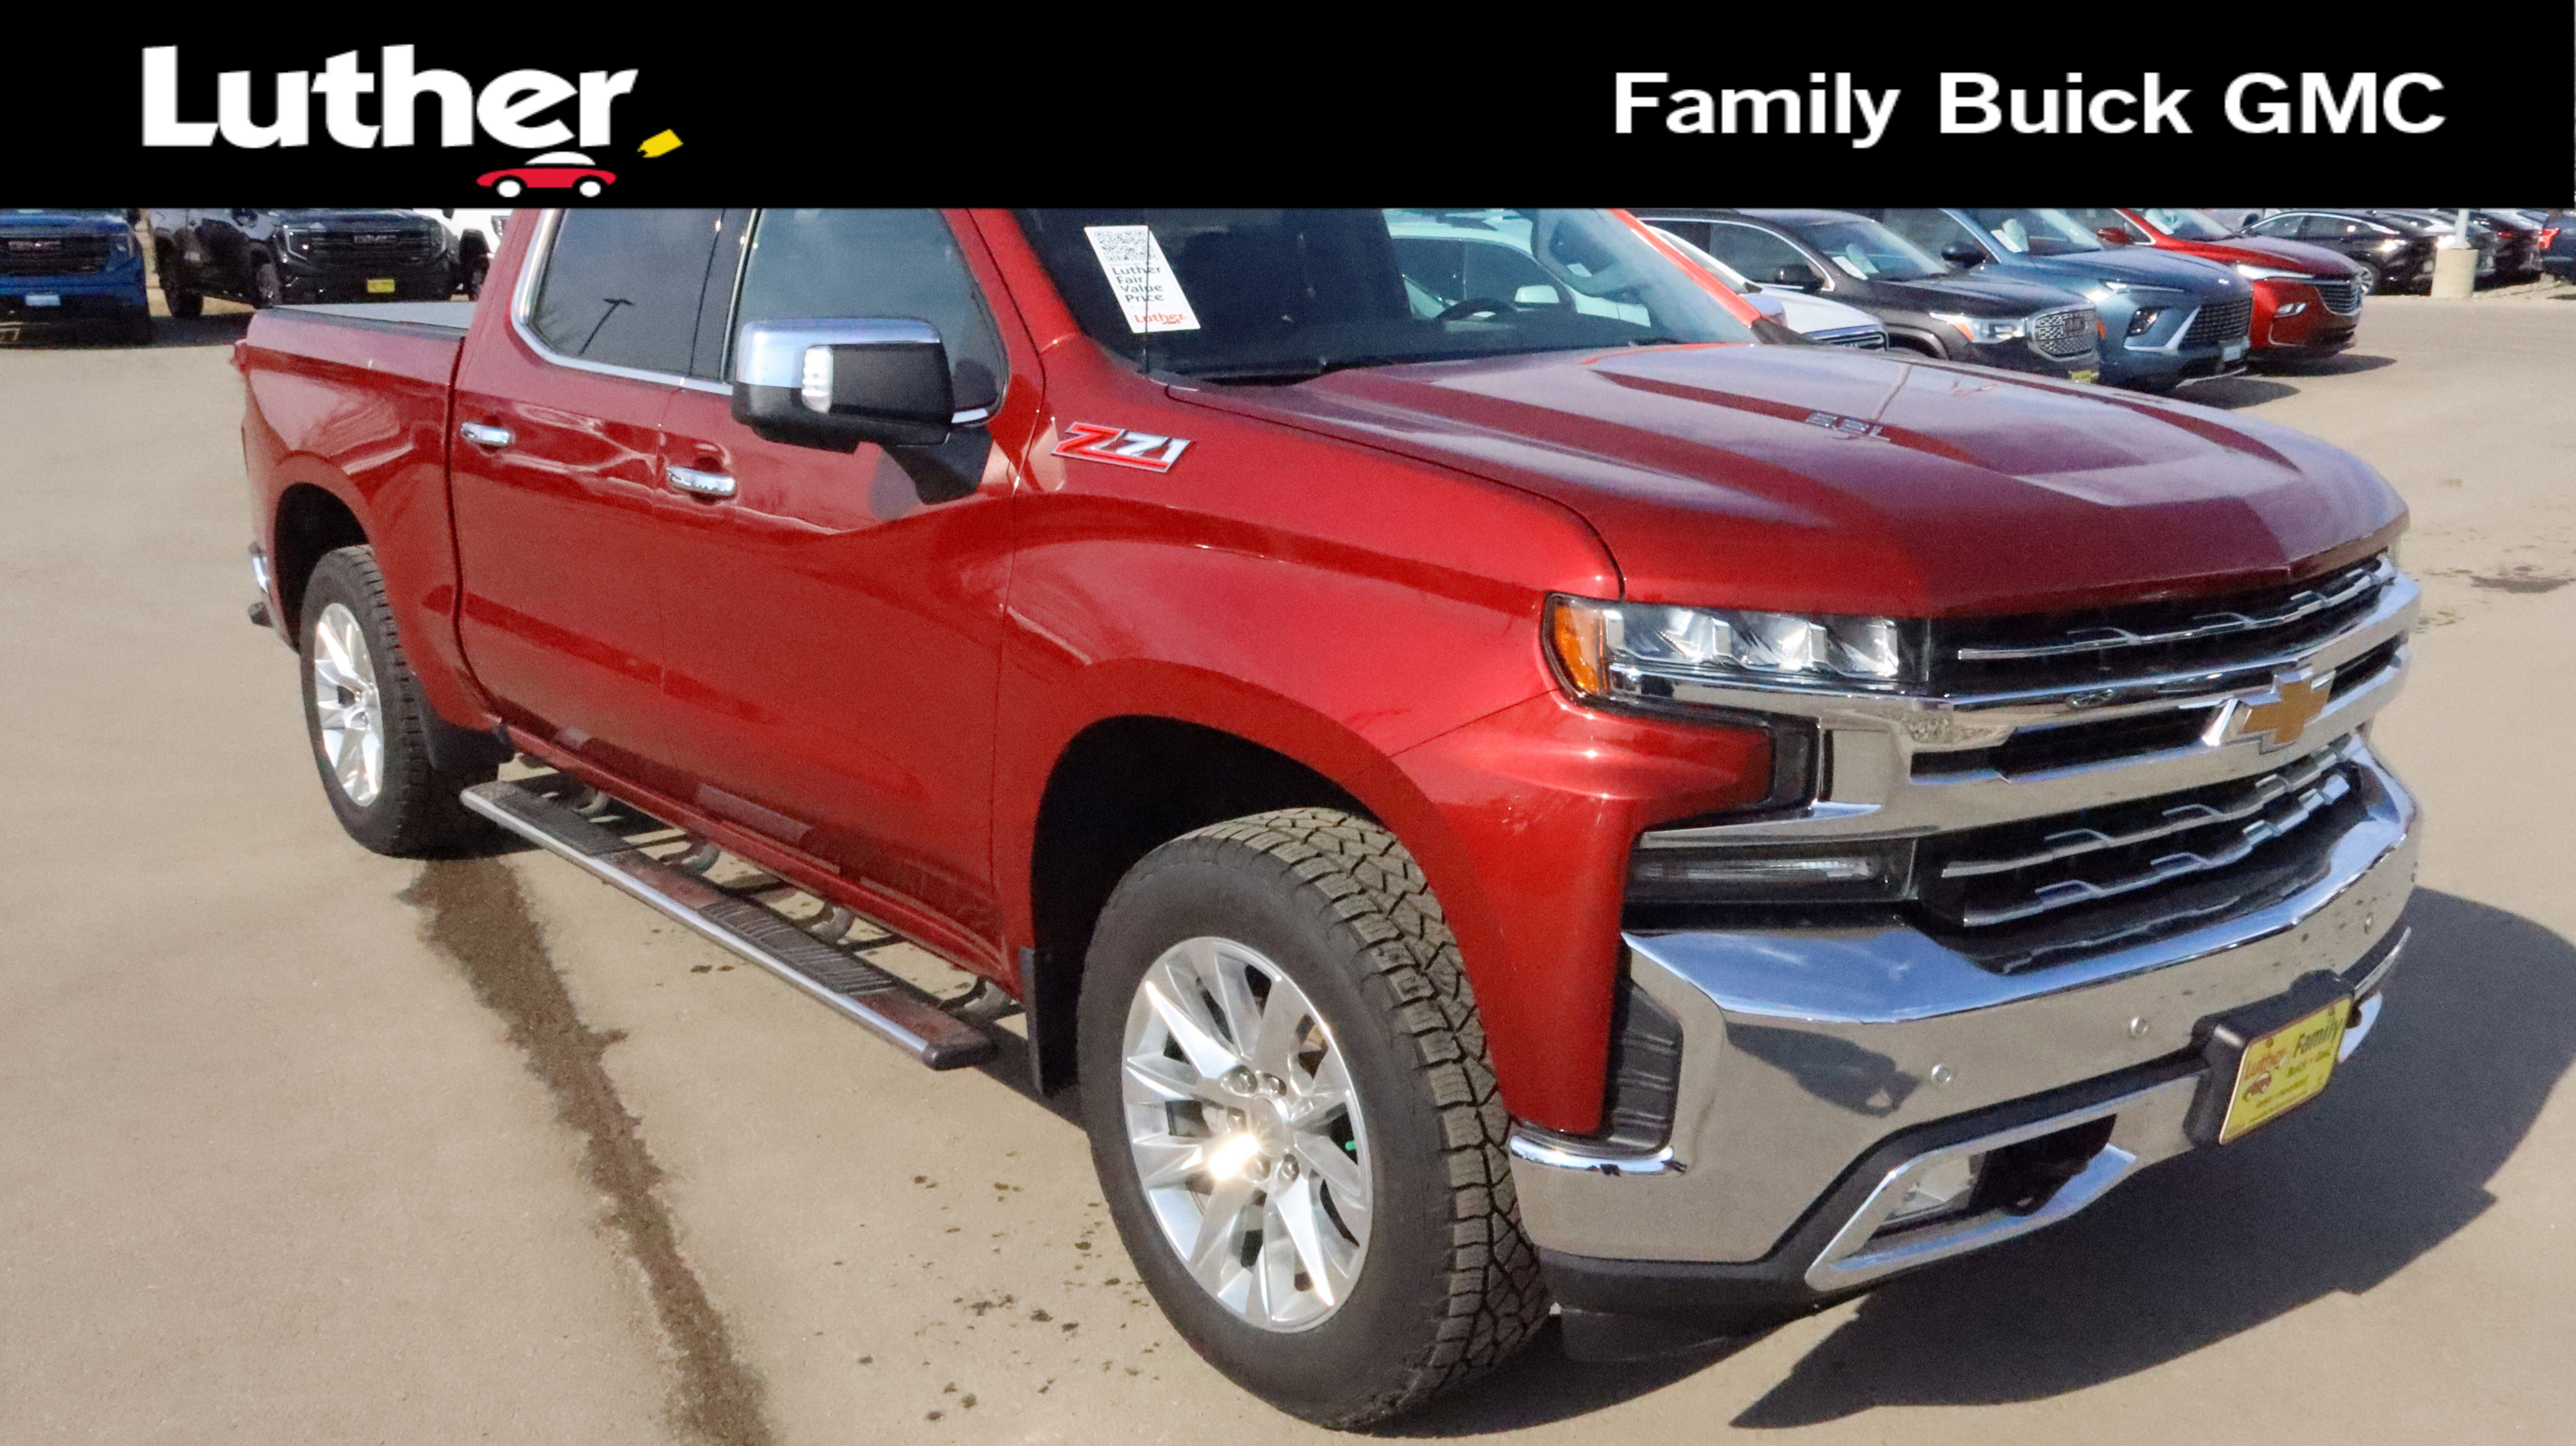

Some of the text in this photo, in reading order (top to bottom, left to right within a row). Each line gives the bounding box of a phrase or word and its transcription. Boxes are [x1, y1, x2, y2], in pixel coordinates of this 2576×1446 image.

[1112, 266, 1161, 275] Luther
[1116, 276, 1143, 284] Fair
[1120, 284, 1164, 293] Value
[1125, 293, 1164, 302] Price
[1134, 313, 1184, 323] Luther
[1050, 421, 1191, 473] Z71
